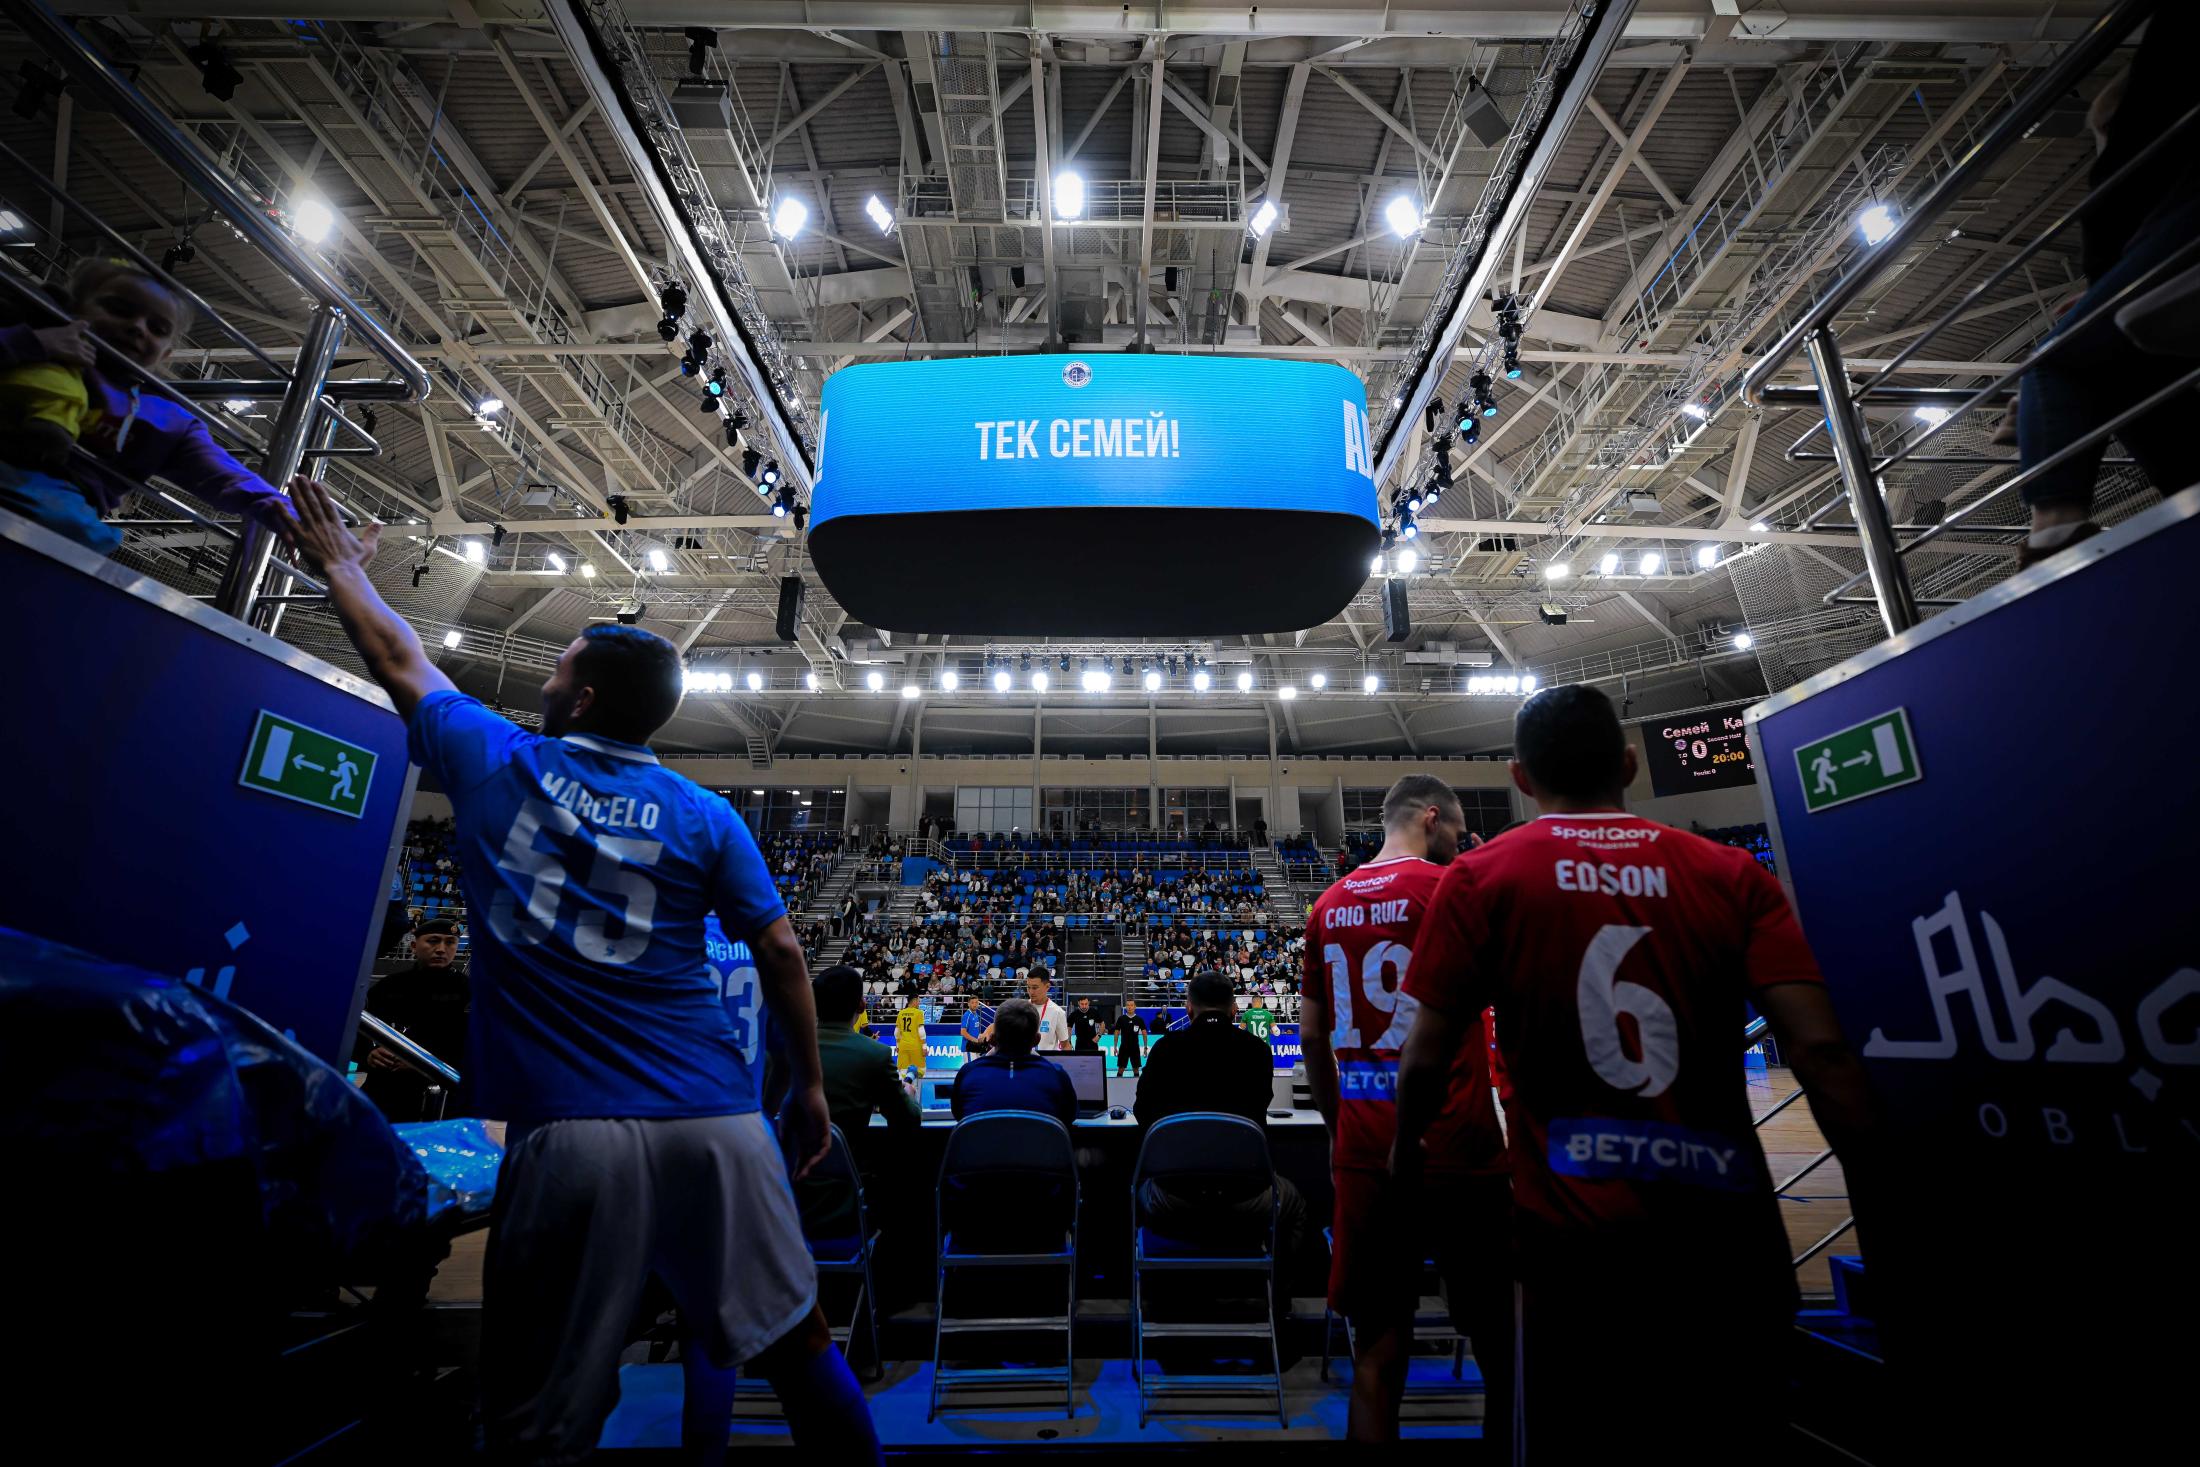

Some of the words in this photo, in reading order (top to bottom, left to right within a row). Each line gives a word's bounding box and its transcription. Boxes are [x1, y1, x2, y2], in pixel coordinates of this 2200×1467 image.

[975, 419, 1040, 461] ТЕК
[1050, 411, 1180, 458] СЕМЕЙ!
[1662, 721, 1710, 739] Семей
[1691, 739, 1707, 759] 0
[1712, 750, 1745, 764] 20:00
[541, 771, 661, 831] MARCELO
[488, 796, 665, 965] 55
[1554, 858, 1669, 899] EDSON
[1325, 904, 1365, 930] CAIO
[1370, 898, 1409, 926] RUIZ
[1323, 939, 1421, 1050] 19
[1576, 923, 1681, 1098] 6
[902, 1016, 912, 1033] 12
[1250, 1020, 1268, 1039] 16
[1564, 1132, 1737, 1176] BETCITY
